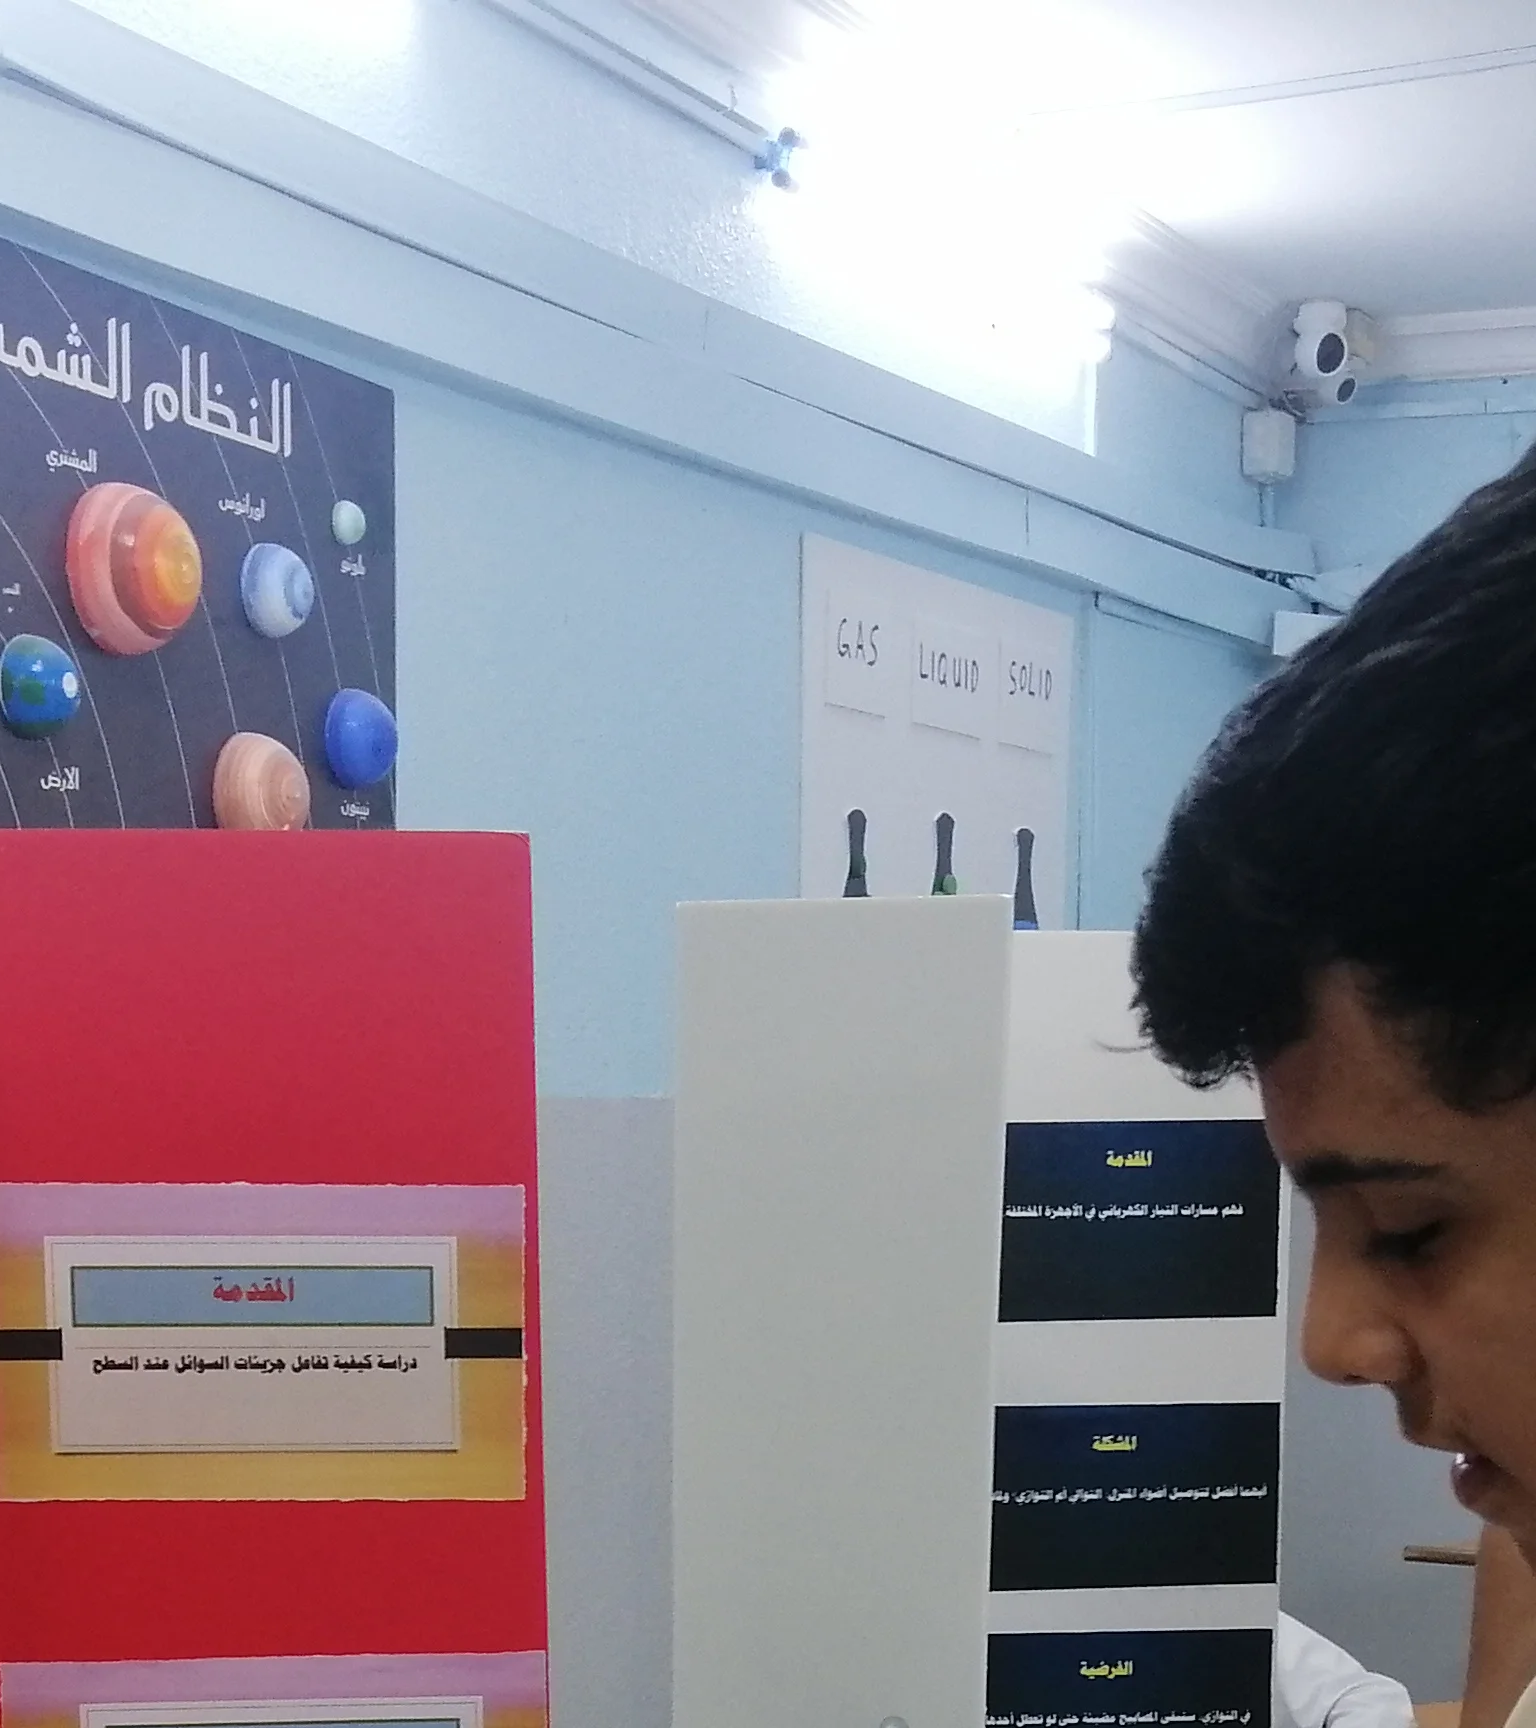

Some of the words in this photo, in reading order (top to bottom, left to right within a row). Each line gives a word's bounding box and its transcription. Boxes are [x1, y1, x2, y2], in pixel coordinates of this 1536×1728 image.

[144, 345, 292, 457] النظام
[45, 448, 98, 474] المشتري
[836, 617, 880, 667] GAS
[919, 643, 980, 694] LIQUID
[1008, 660, 1053, 701] SOLID
[1106, 1150, 1154, 1168] المقدمة
[1149, 1203, 1178, 1219] التيار
[1180, 1203, 1219, 1219] مسارات
[212, 1275, 295, 1303] المقدمة
[92, 1355, 140, 1376] السطح
[143, 1356, 170, 1372] عند
[174, 1353, 230, 1374] السوائل
[291, 1354, 329, 1374] تفاعل
[332, 1353, 373, 1376] كيفية
[377, 1353, 419, 1374] دراسة
[1091, 1434, 1139, 1453] المشكلة
[1079, 1660, 1134, 1679] الفرضية
